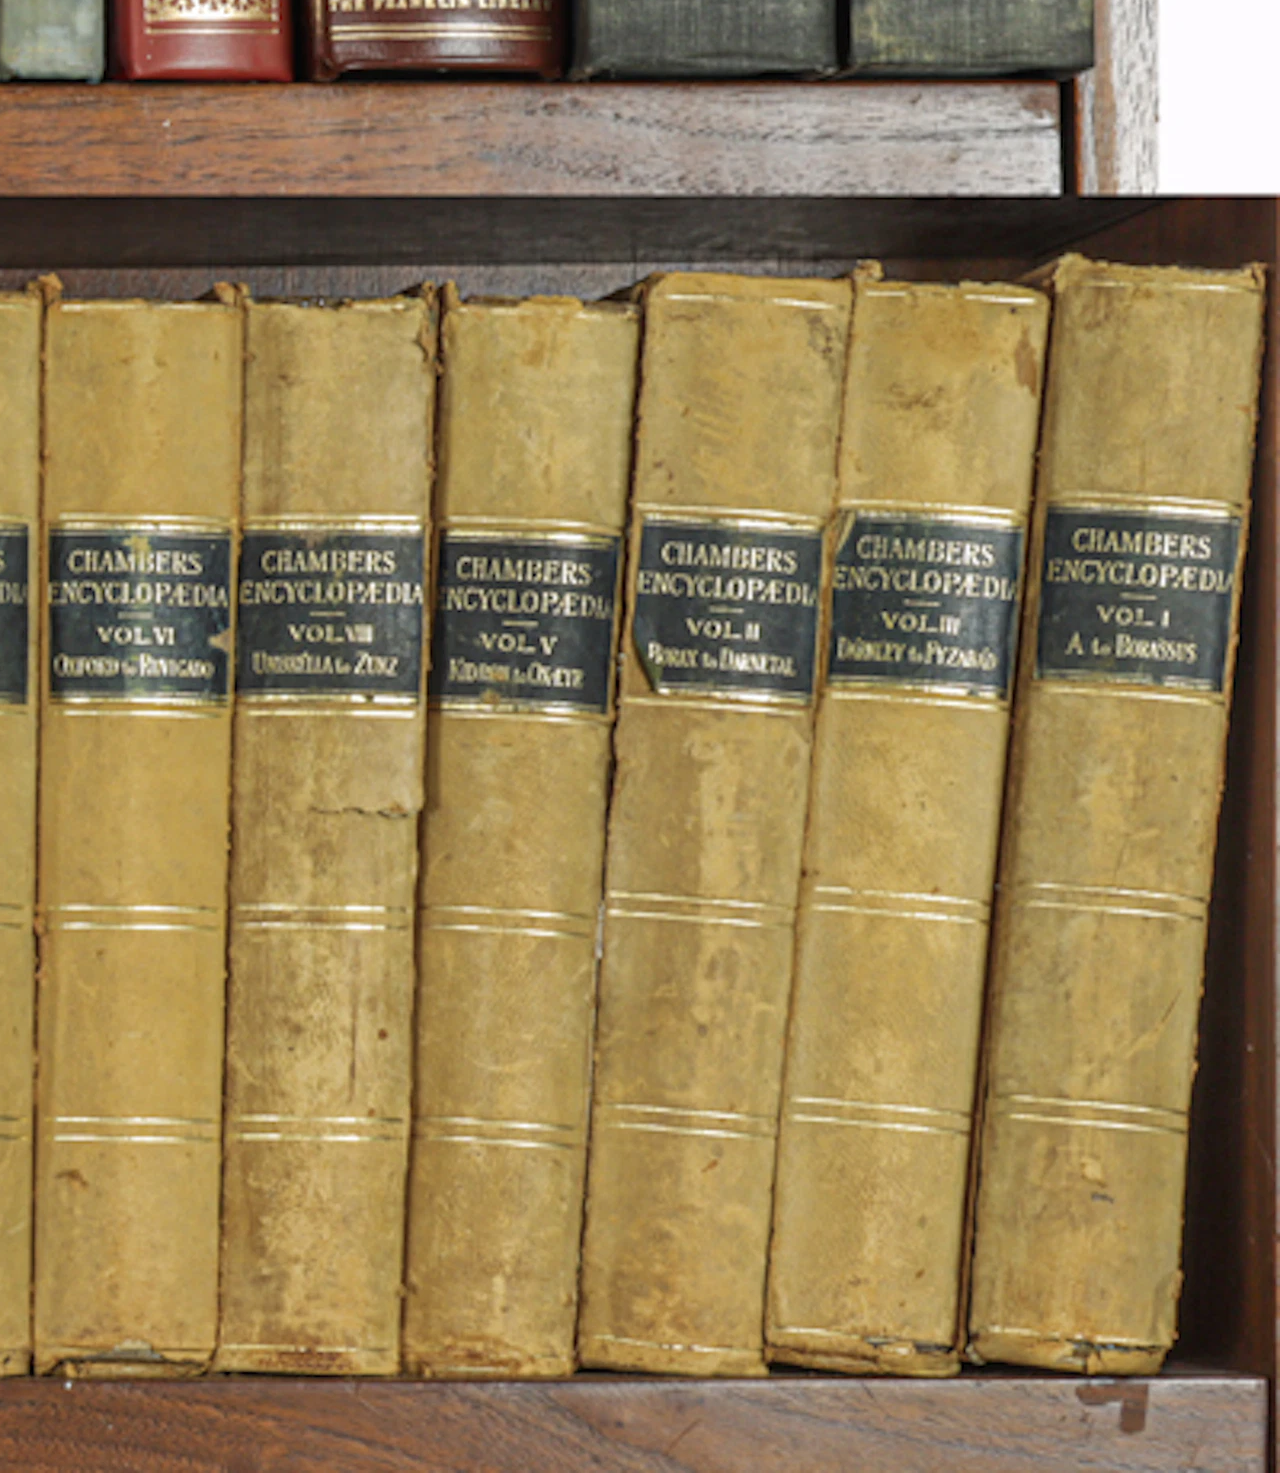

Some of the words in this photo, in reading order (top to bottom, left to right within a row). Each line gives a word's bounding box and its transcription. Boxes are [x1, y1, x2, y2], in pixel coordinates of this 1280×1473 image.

[661, 539, 798, 575] CHAMBERS
[856, 536, 994, 568] CHAMBERS
[1072, 528, 1212, 559] CHAMBERS
[67, 550, 203, 576] CHAMBERS
[261, 550, 396, 575] CHAMBERS
[456, 556, 592, 585] CHAMBERS
[1047, 560, 1235, 594] ENCYCLOPÆDIA
[48, 581, 228, 608] ENCYCLOPÆDIA
[239, 581, 424, 606] ENCYCLOPÆDIA
[1064, 632, 1084, 655] A
